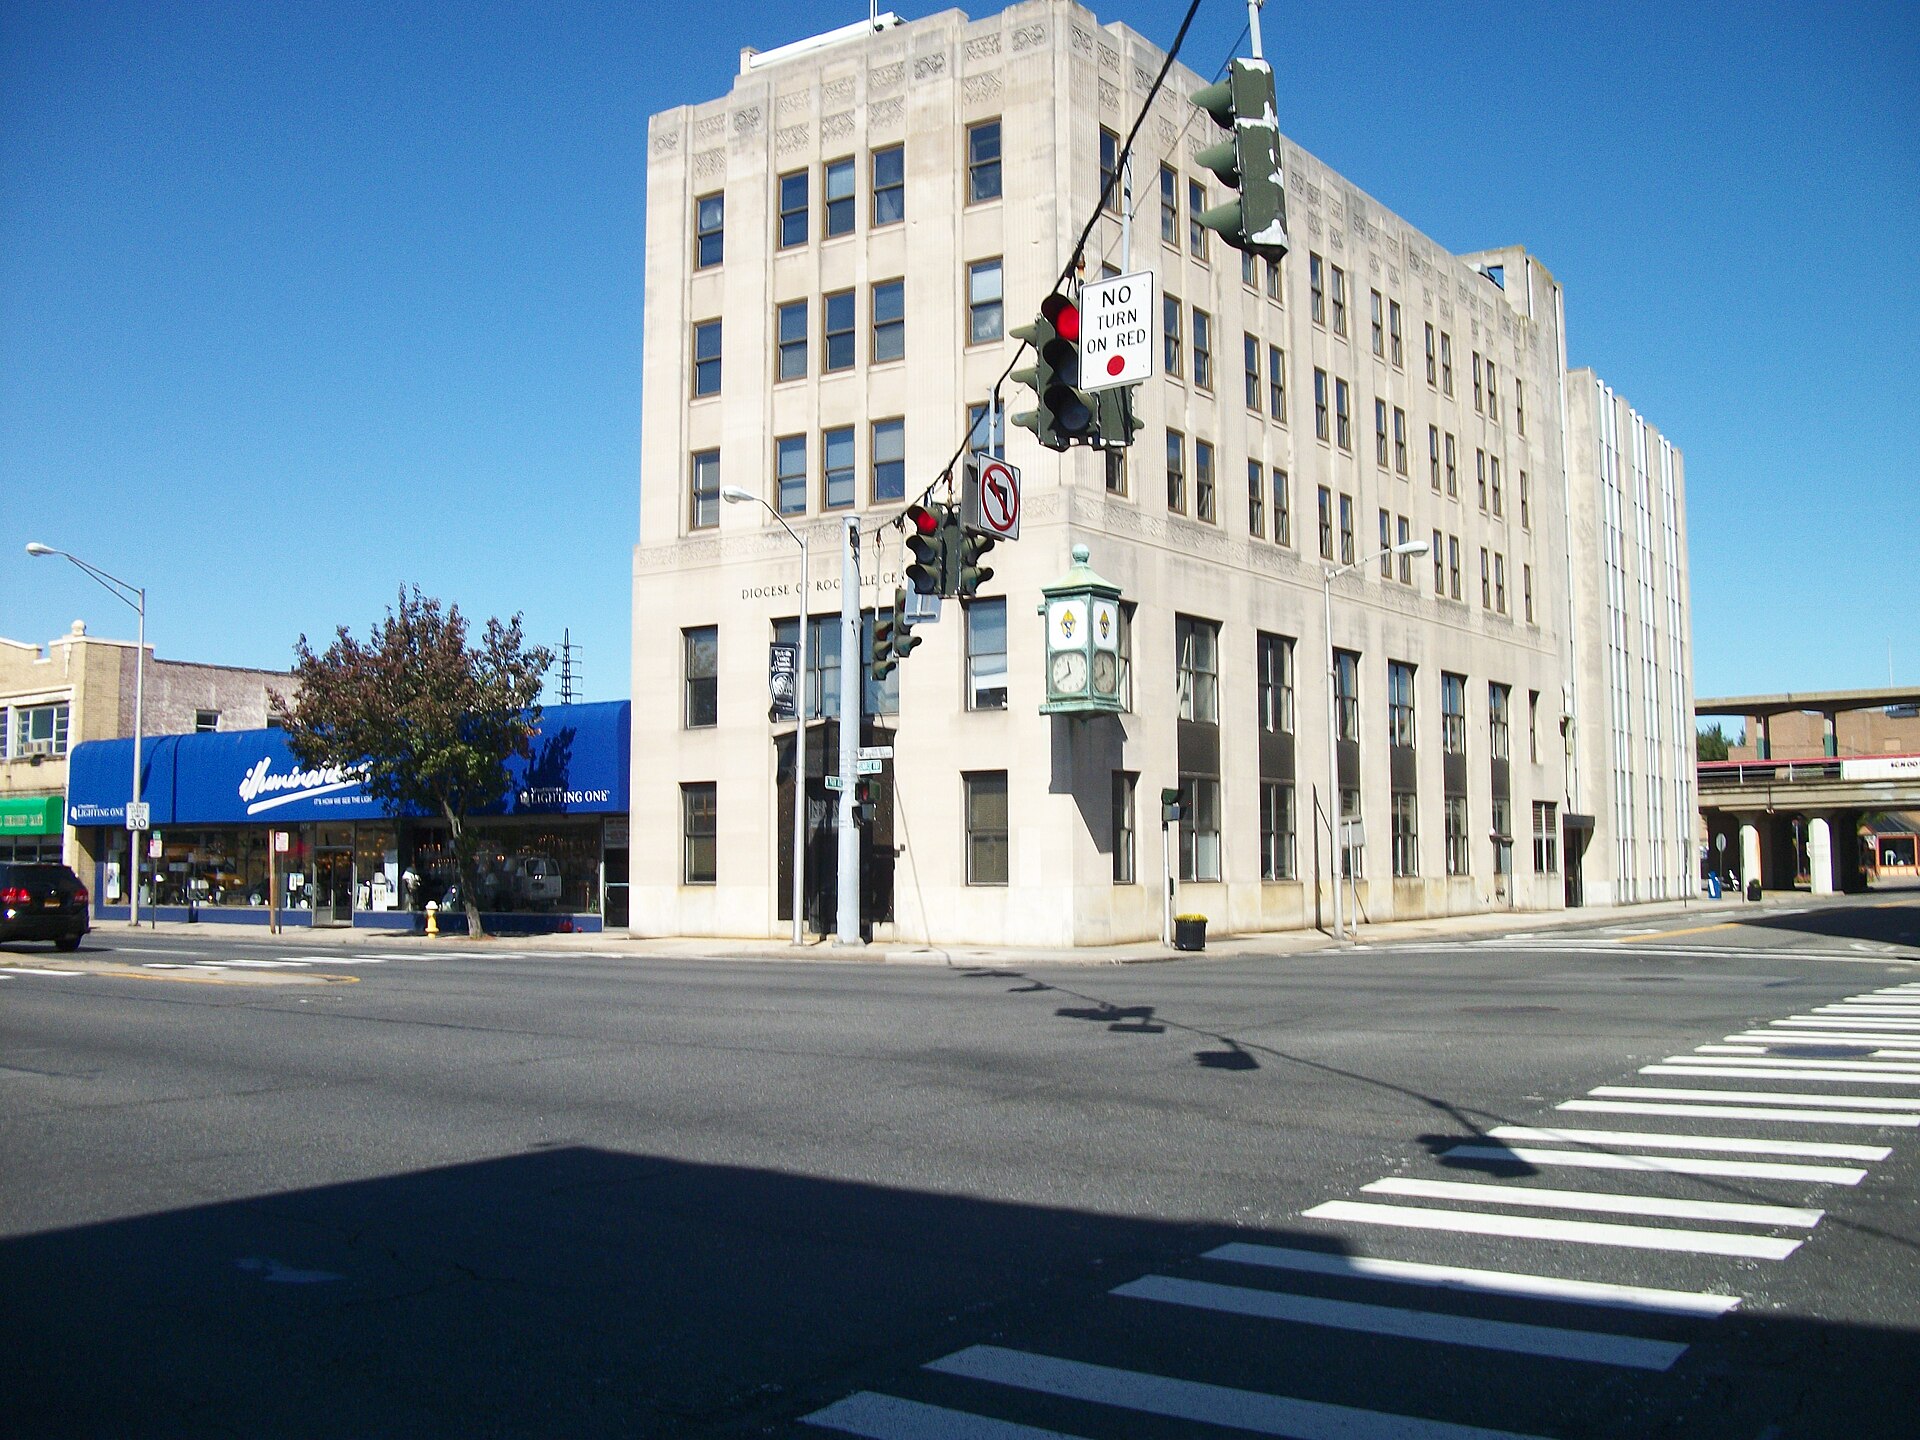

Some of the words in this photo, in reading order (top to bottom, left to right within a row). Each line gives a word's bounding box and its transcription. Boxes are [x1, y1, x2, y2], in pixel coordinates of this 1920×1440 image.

[1102, 285, 1132, 308] NO
[1097, 308, 1137, 330] TURN
[1086, 336, 1107, 355] ON
[1116, 328, 1146, 348] RED
[742, 584, 790, 600] DIOCESE
[816, 574, 876, 592] ROCLLE
[530, 790, 583, 804] LIGHTING
[584, 789, 608, 802] ONE
[77, 808, 110, 818] LIGHTING
[110, 807, 124, 817] ONE
[129, 818, 146, 828] 30
